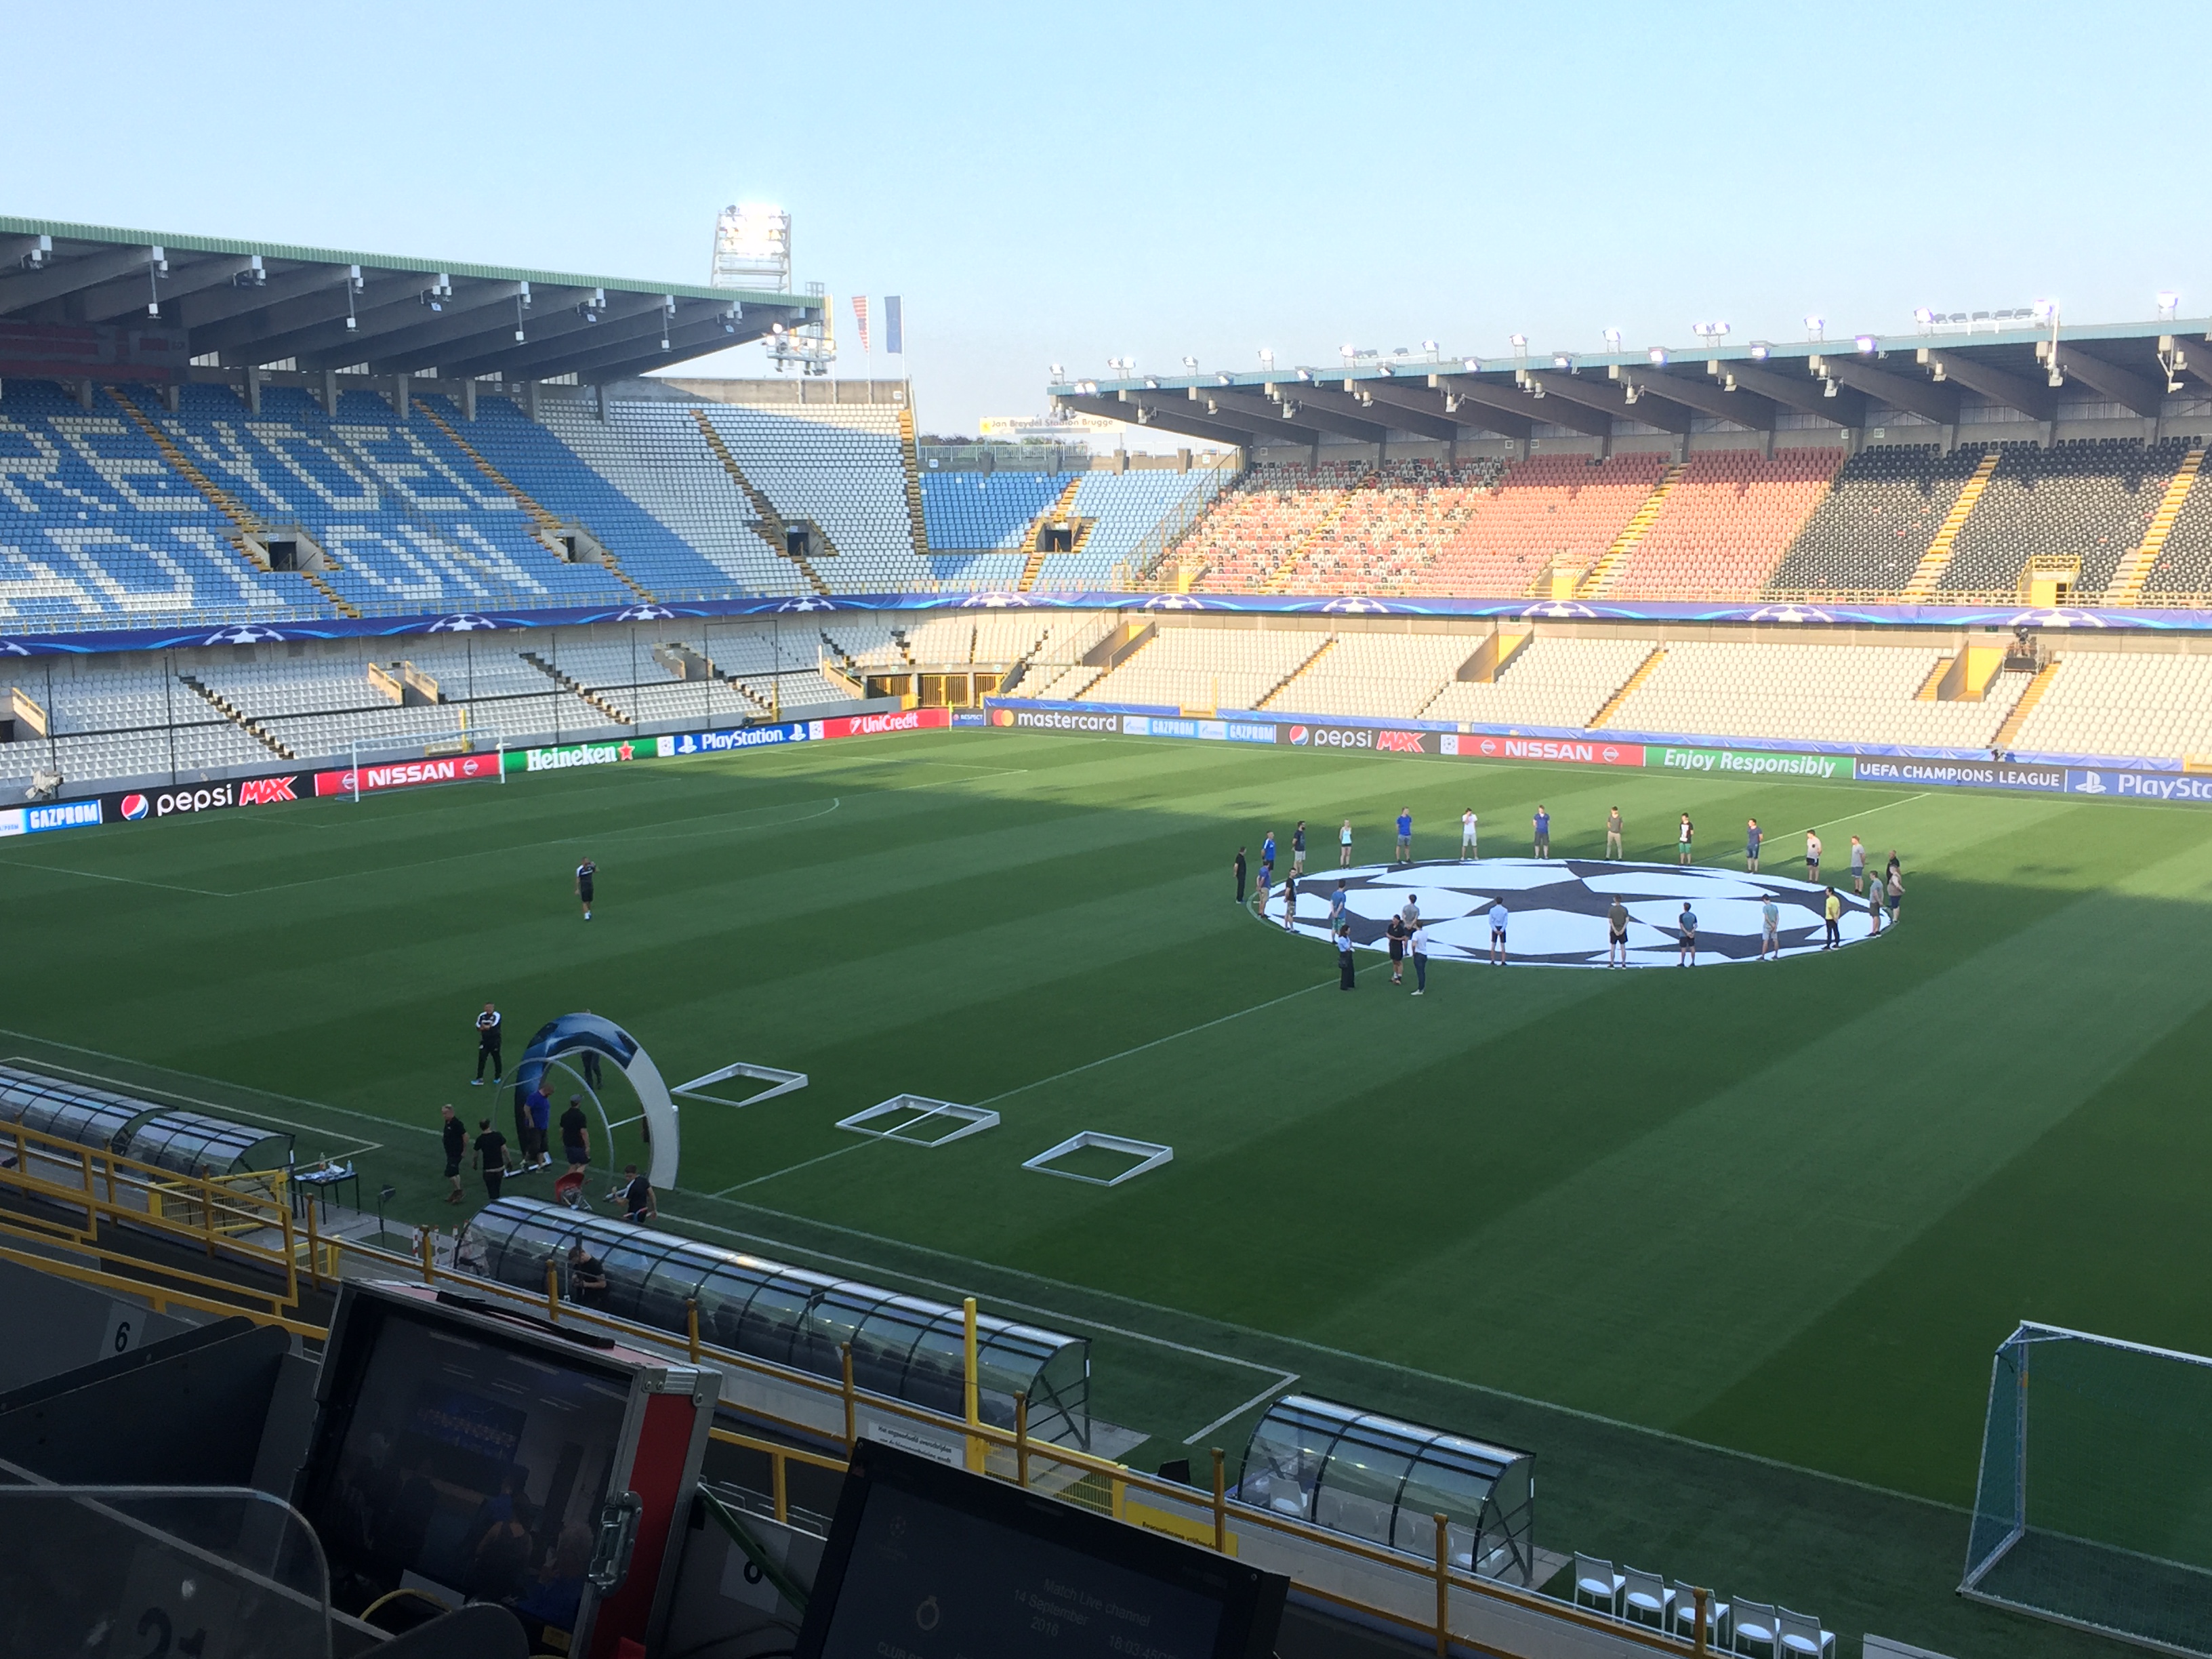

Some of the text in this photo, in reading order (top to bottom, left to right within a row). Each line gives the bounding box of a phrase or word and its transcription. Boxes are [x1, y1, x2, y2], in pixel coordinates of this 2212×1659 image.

[1009, 419, 1042, 430] Breydel
[1045, 418, 1078, 427] Stadion
[1082, 418, 1113, 428] Brugge
[863, 712, 918, 734] UniCredit
[1018, 712, 1117, 732] mastercard
[1152, 720, 1194, 736] GAZPROM
[1229, 724, 1273, 741] GAZPROM
[702, 729, 783, 750] PlayStation
[1314, 729, 1425, 753] pepsi MAX
[1504, 740, 1593, 761] NISSAN
[526, 743, 617, 771] Heineken
[1664, 748, 1837, 779] Enjoy Responsibly
[368, 761, 455, 787] NISSAN
[1860, 763, 2061, 787] UEFA CHAMPIONS LEAGUE
[157, 775, 298, 817] pepsi MAX
[30, 803, 98, 830] GAZPROM
[115, 1322, 131, 1353] 6
[1014, 1589, 1090, 1626] 14 September
[1044, 1578, 1151, 1628] Match Live channel
[1030, 1616, 1059, 1637] 2016
[878, 1641, 907, 1659] CLUB
